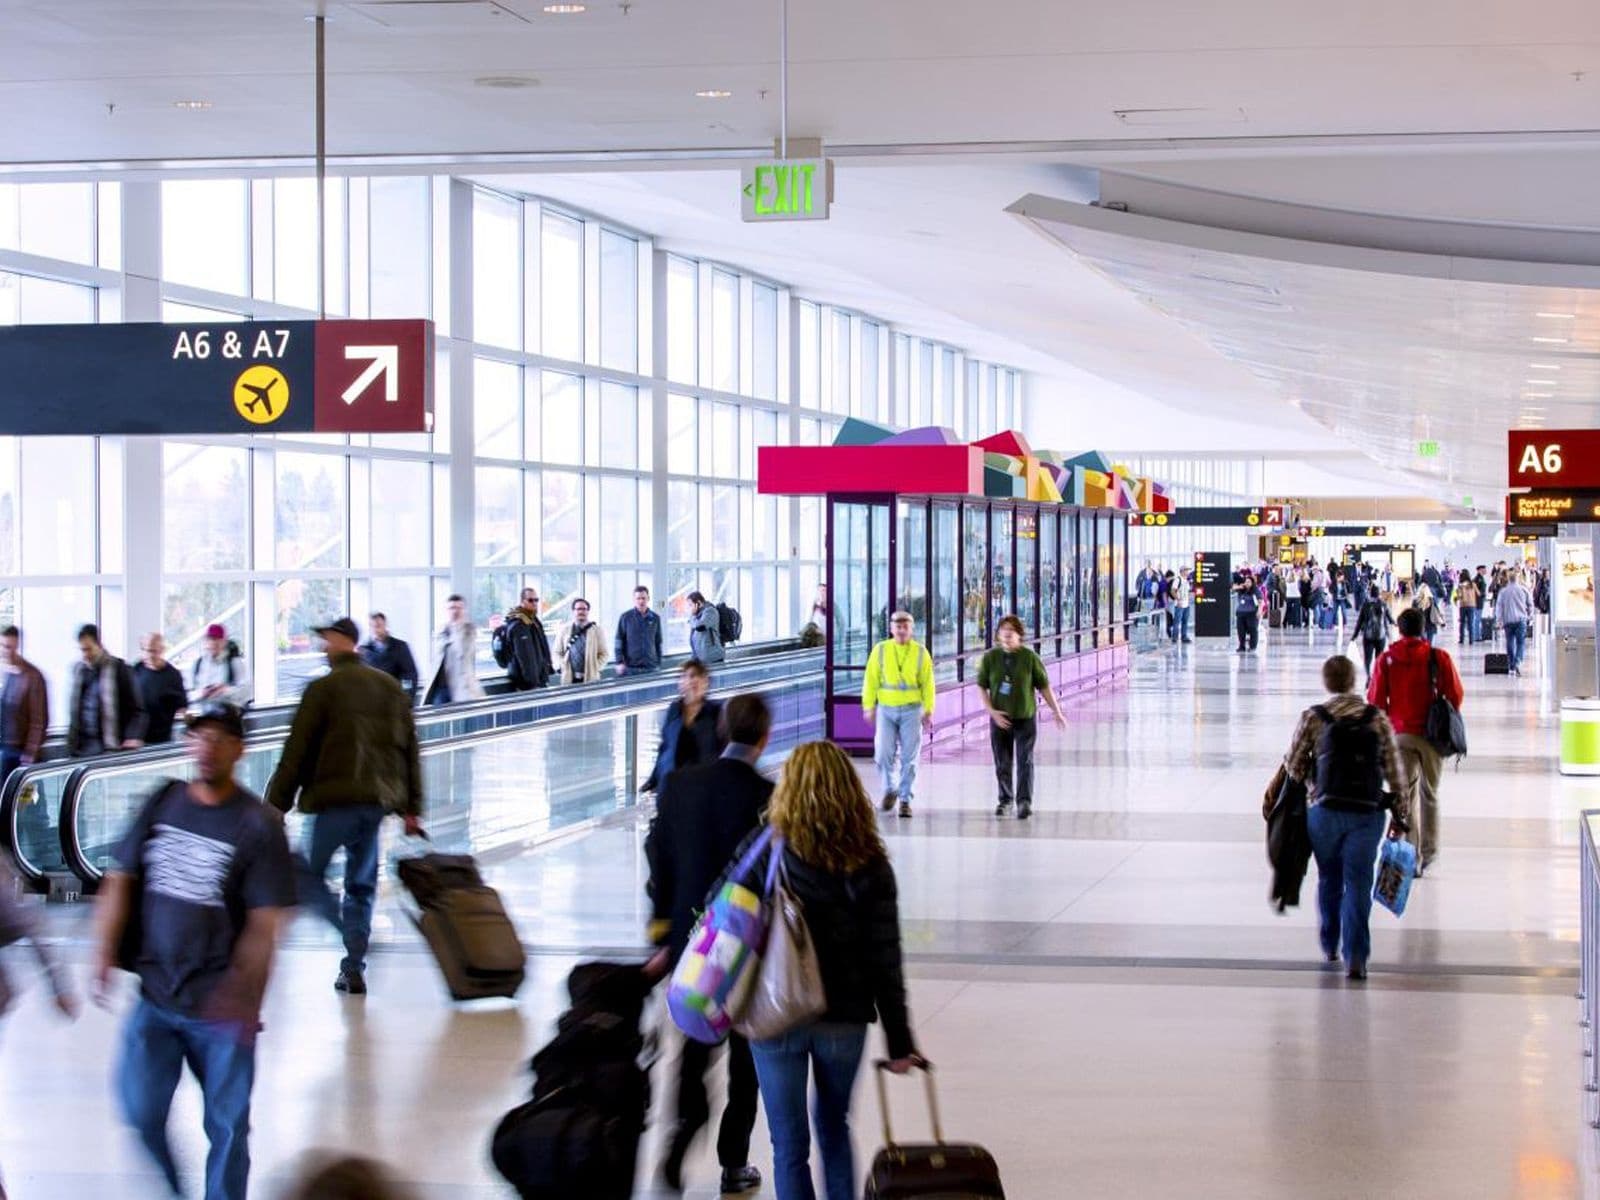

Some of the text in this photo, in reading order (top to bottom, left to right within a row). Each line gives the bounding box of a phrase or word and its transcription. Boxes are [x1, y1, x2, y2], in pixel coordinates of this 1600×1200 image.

[754, 164, 817, 216] EXIT
[172, 329, 291, 359] A6 & A7
[1518, 444, 1563, 474] A6
[1518, 497, 1572, 508] Portland
